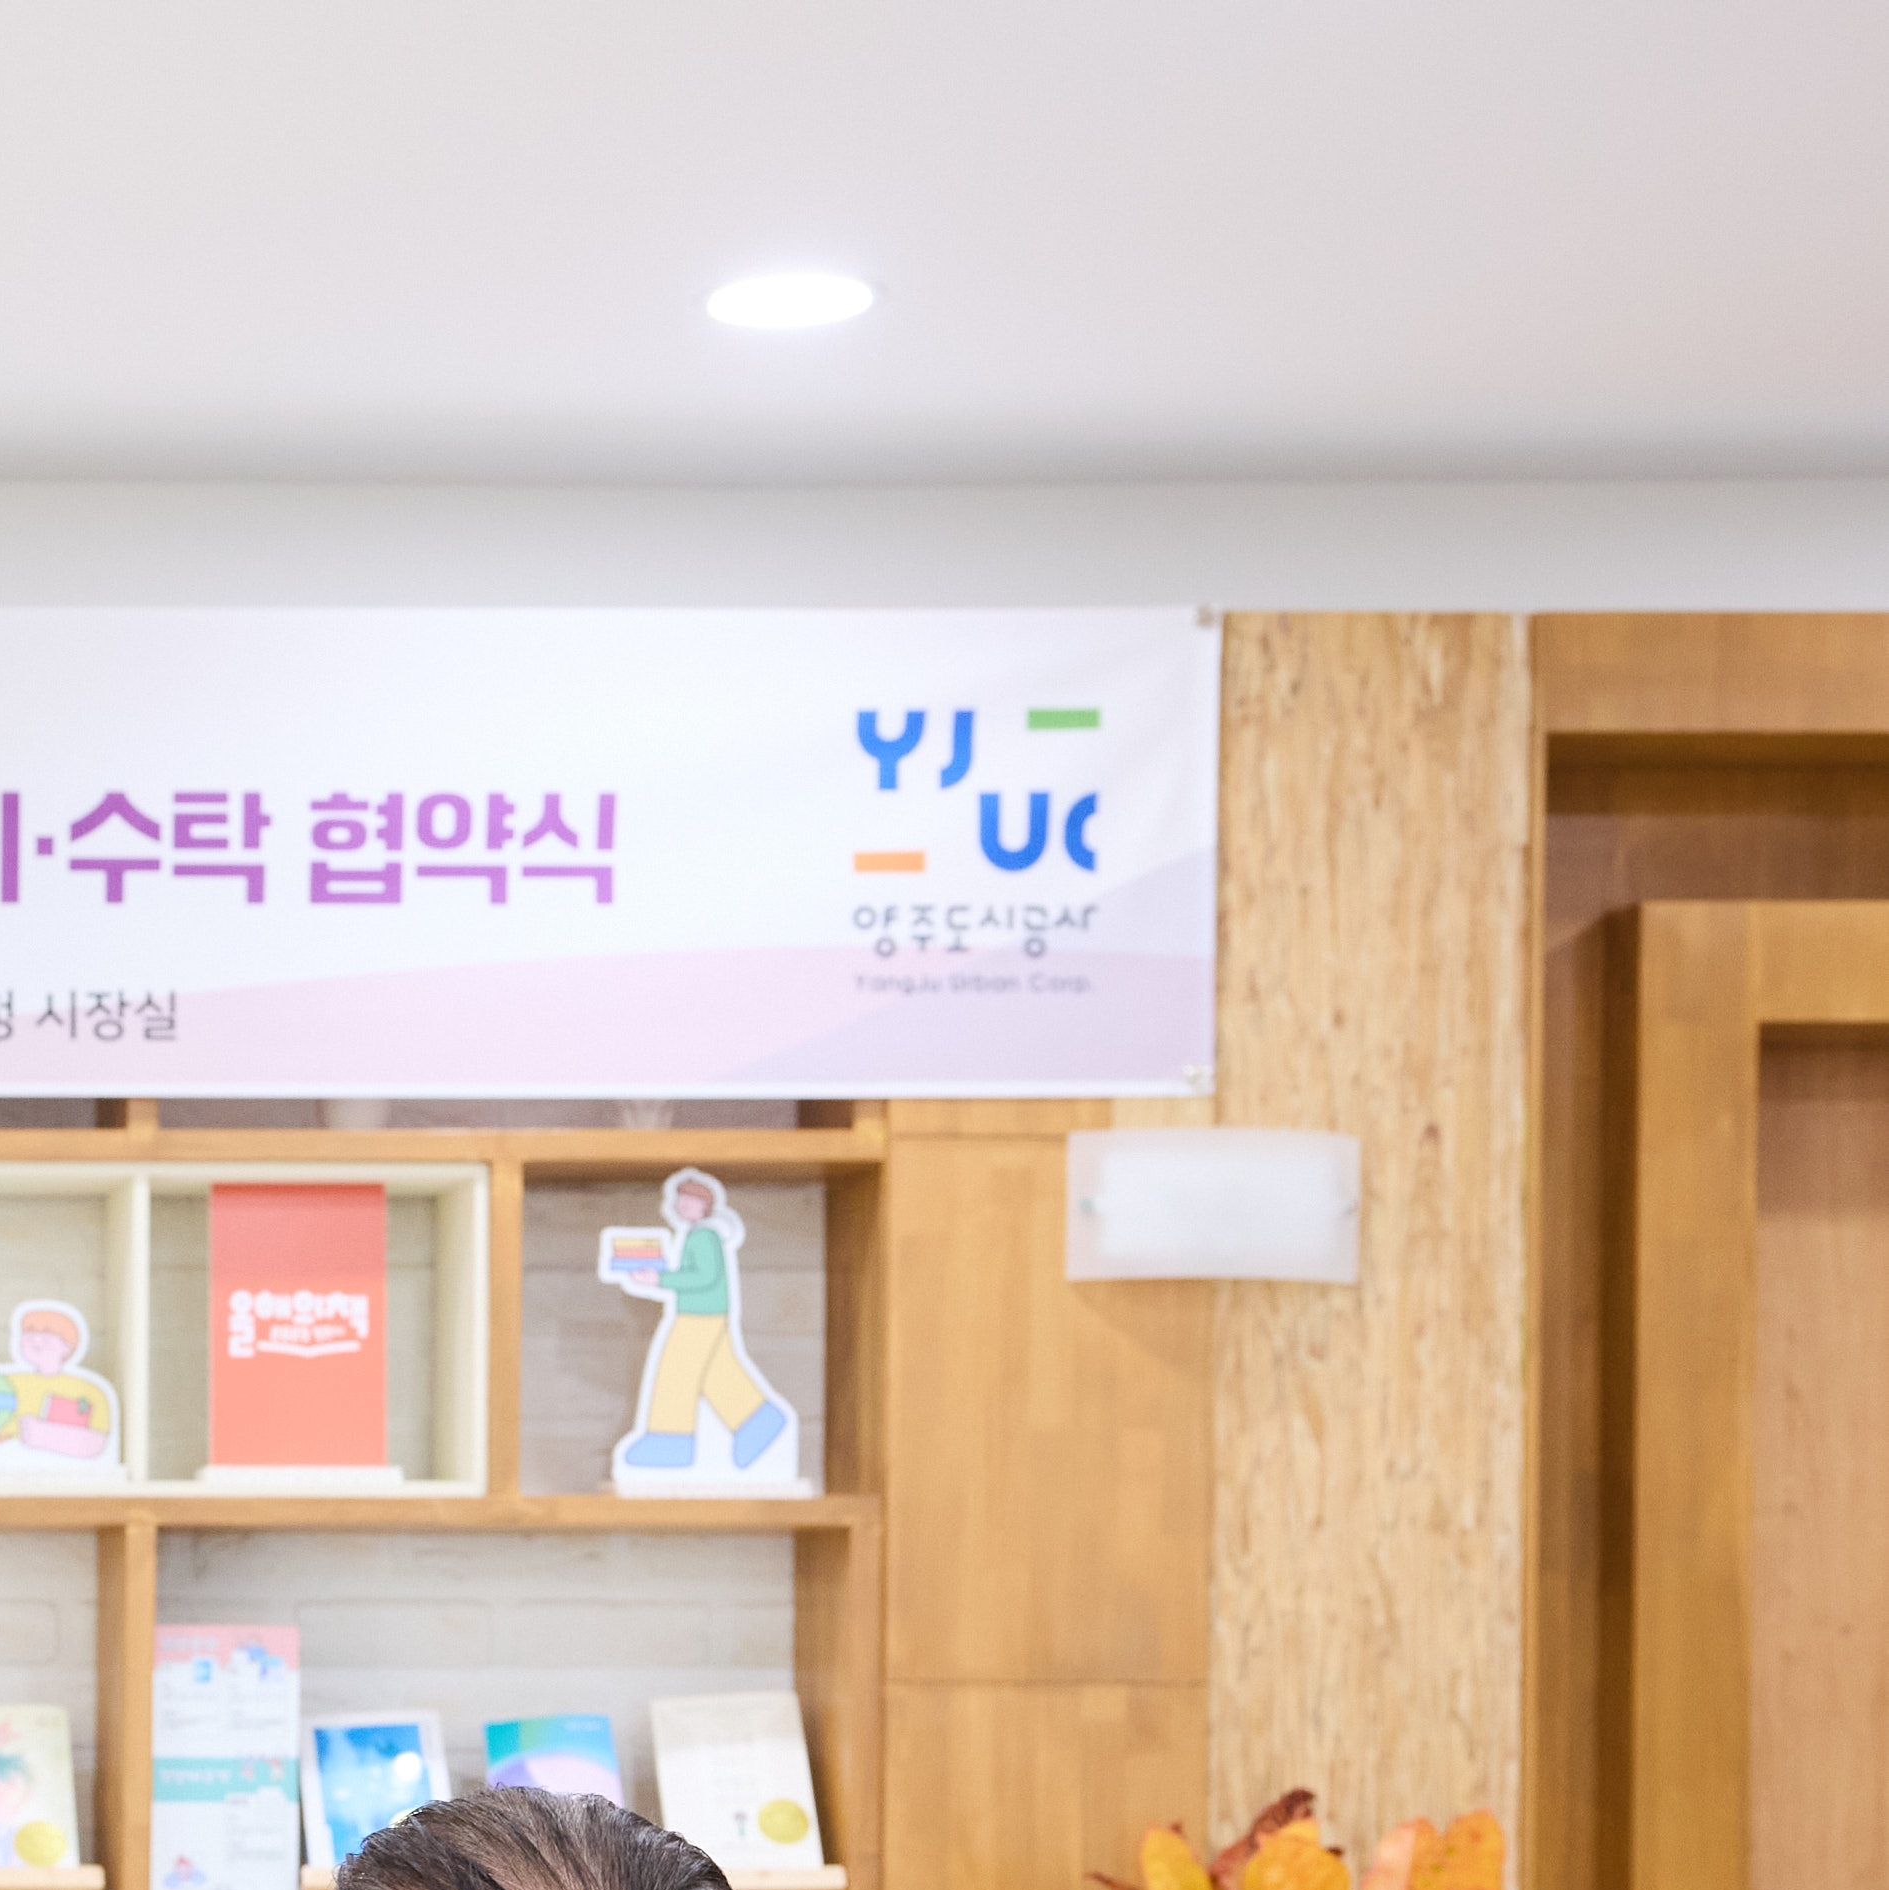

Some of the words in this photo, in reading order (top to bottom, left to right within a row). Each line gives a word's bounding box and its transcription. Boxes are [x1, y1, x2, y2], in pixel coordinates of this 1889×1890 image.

[309, 792, 617, 904] 협약식
[853, 904, 1098, 960] 양주도시공사
[35, 990, 177, 1042] 시장실
